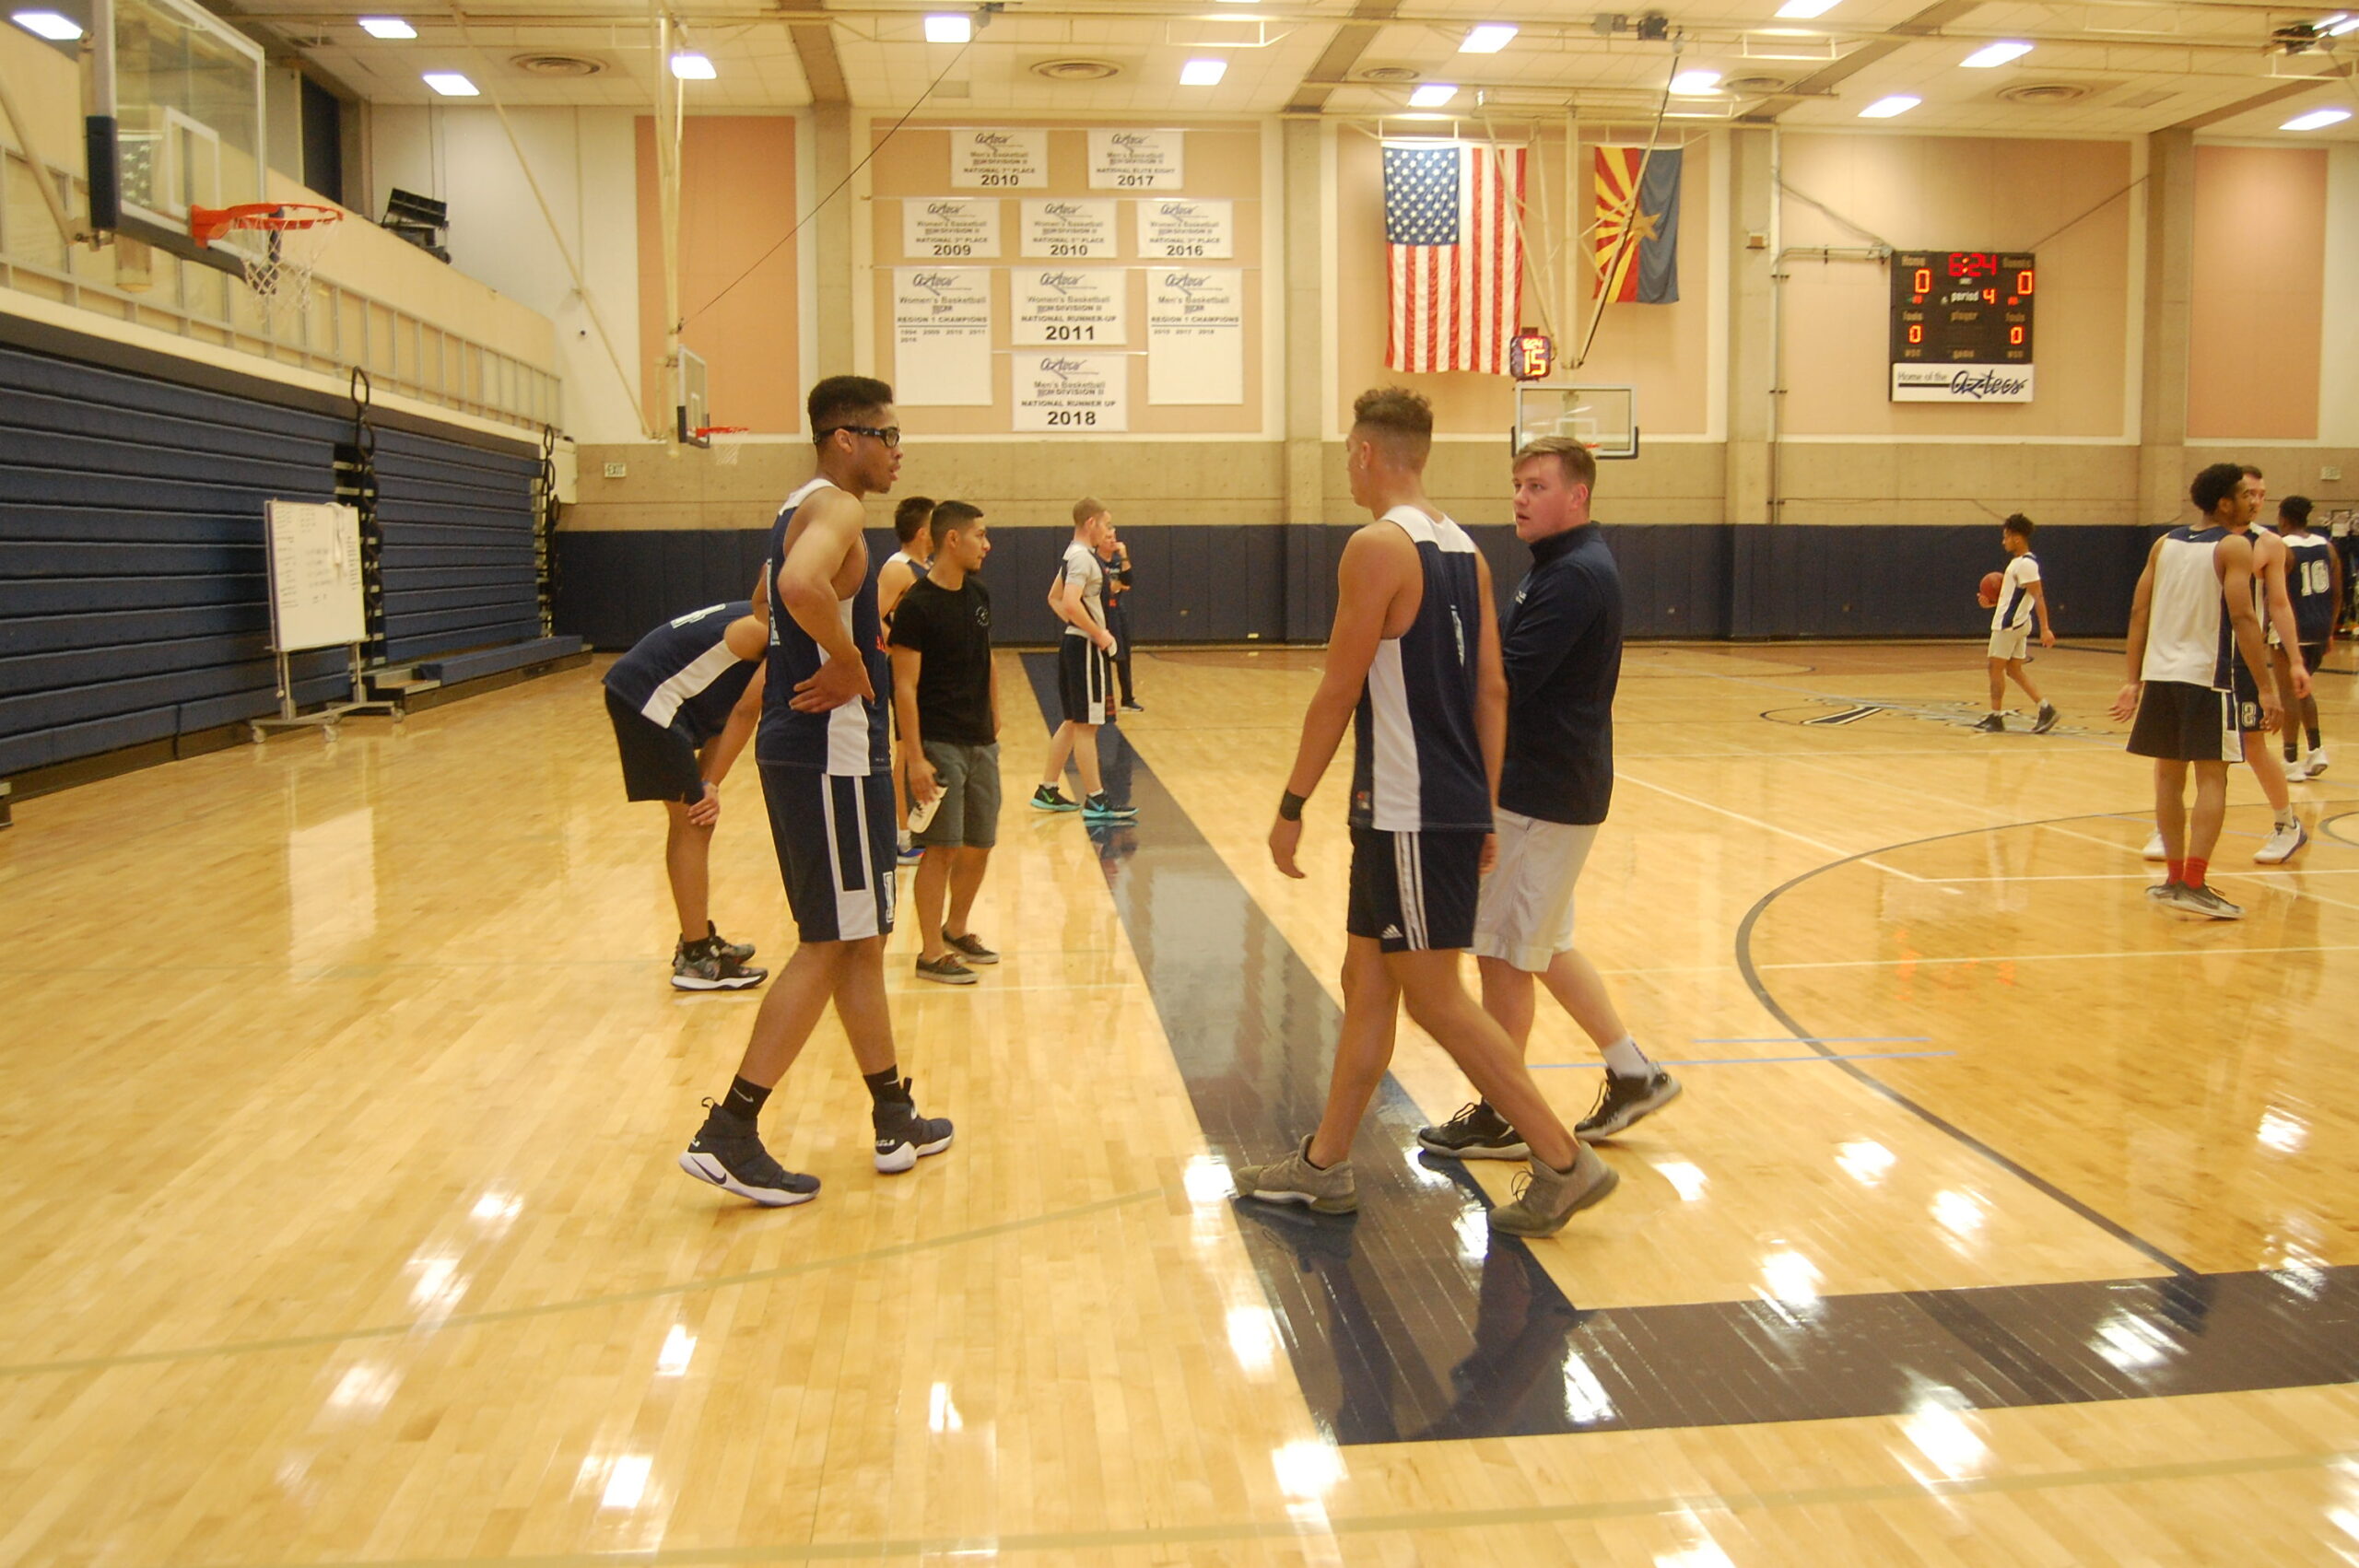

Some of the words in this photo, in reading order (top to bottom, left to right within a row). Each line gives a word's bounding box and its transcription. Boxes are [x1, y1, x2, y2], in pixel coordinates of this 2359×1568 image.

[980, 174, 1018, 186] 2010
[1117, 175, 1155, 186] 2017
[933, 244, 971, 256] 2009
[1050, 244, 1088, 256] 2010
[1167, 244, 1204, 256] 2016
[1949, 252, 1997, 276] 6:24
[1915, 268, 1931, 294] 0
[2017, 270, 2033, 295] 0
[1951, 291, 1979, 303] period
[1982, 288, 1995, 305] 4
[1046, 325, 1094, 341] 2011
[1908, 325, 1922, 344] 0
[2011, 326, 2024, 345] 0
[1523, 348, 1547, 376] 15
[1047, 411, 1097, 426] 2018
